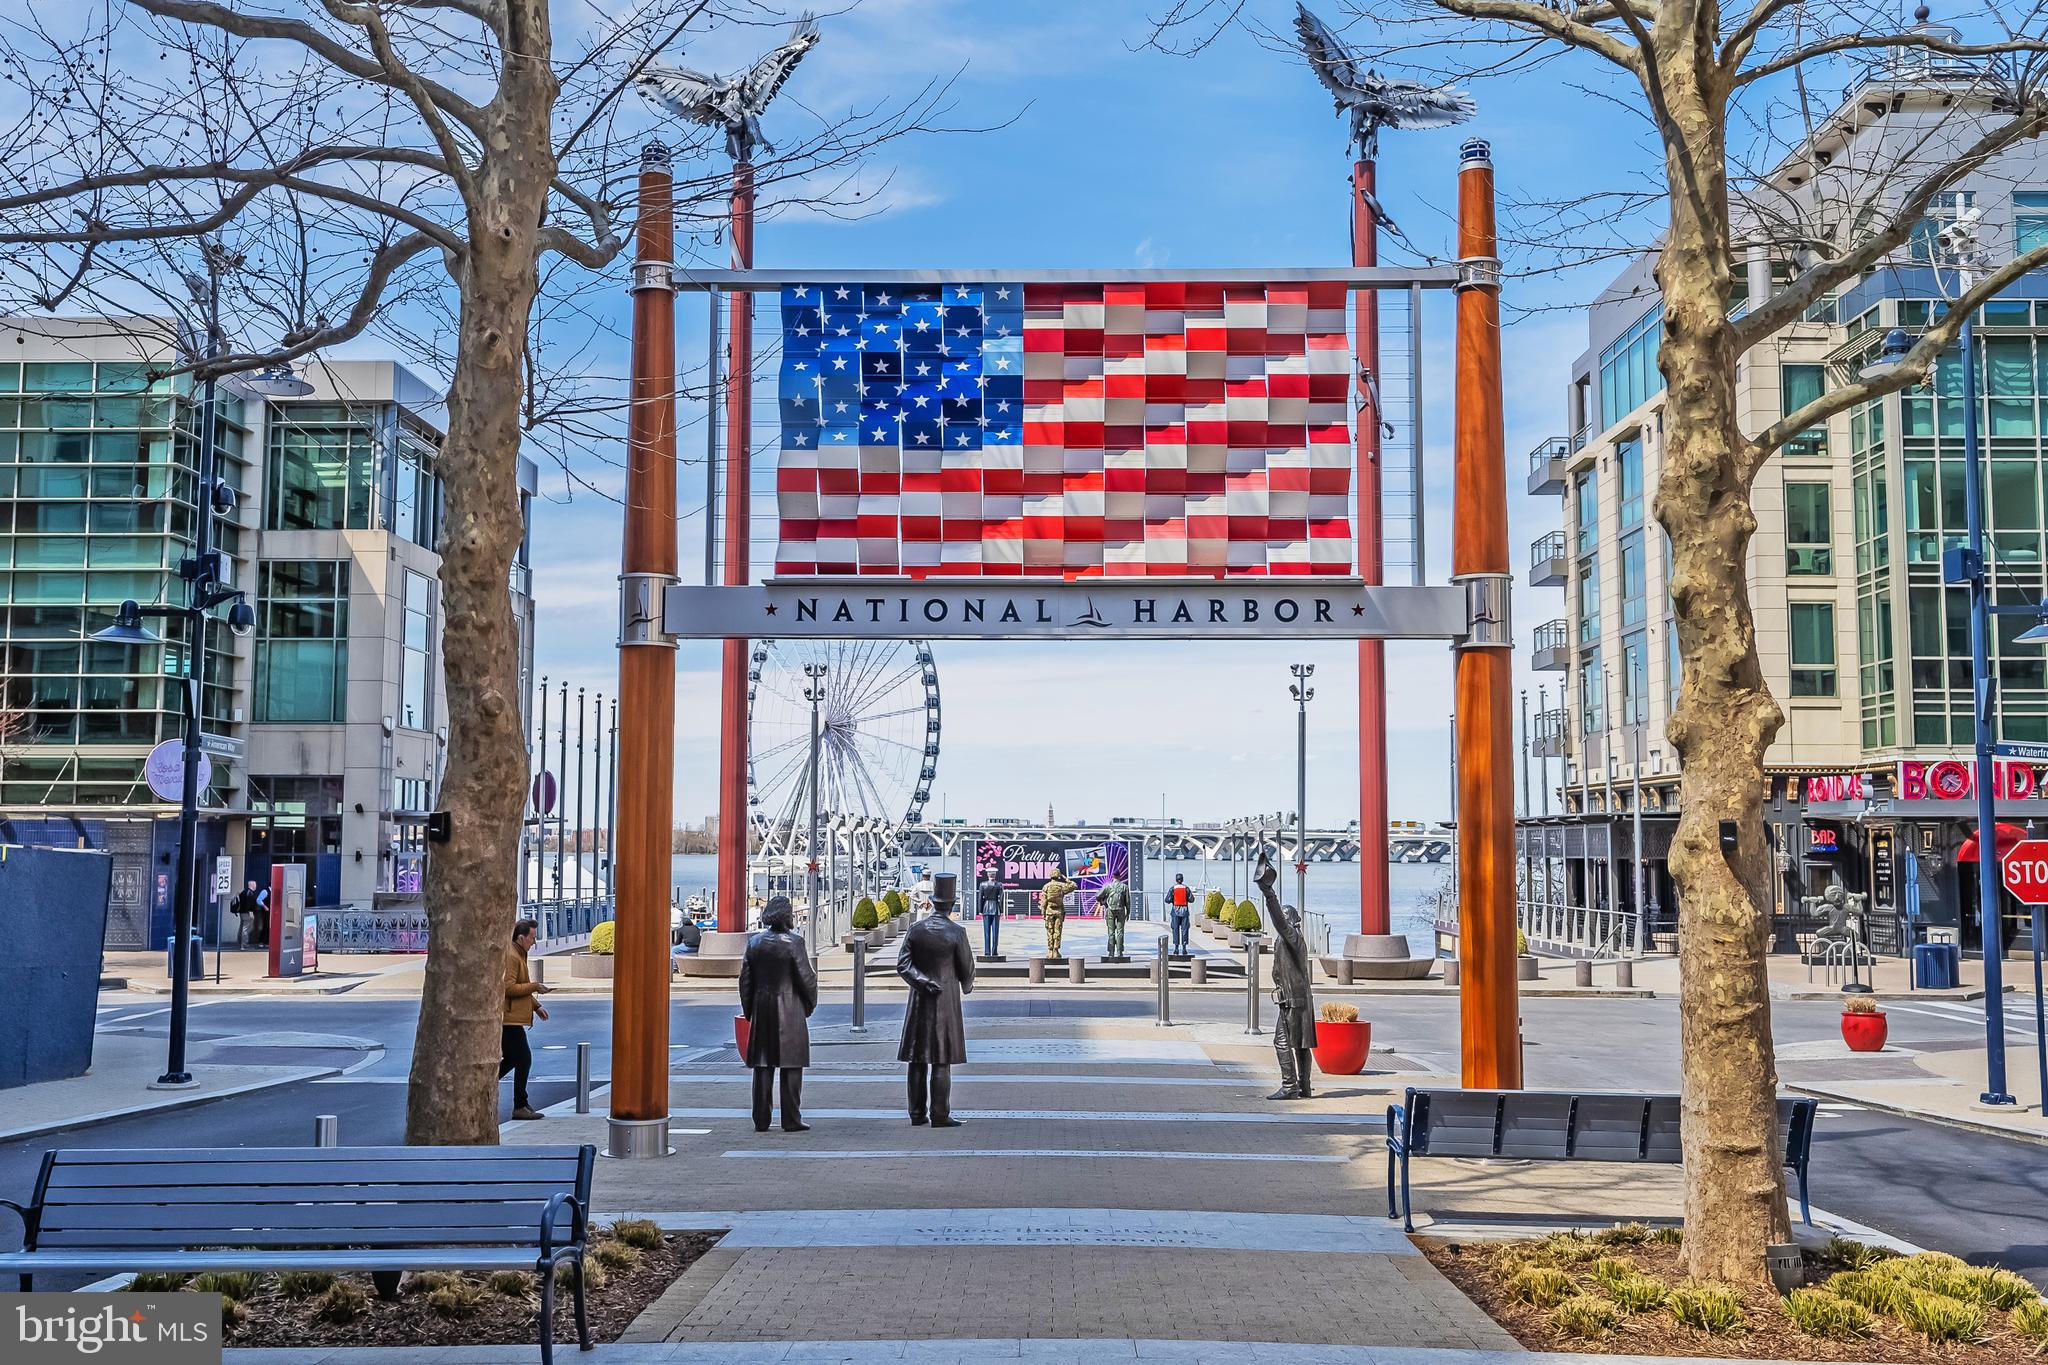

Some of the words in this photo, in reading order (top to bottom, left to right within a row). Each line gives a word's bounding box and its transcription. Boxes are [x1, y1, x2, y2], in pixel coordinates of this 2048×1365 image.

[795, 599, 1052, 622] NATIONAL
[1133, 599, 1335, 623] HARBOR
[1808, 776, 1845, 803] BOND
[1848, 774, 1864, 801] 45
[1811, 829, 1836, 844] BAR
[1002, 844, 1046, 864] Pretty
[1049, 851, 1060, 861] in
[1004, 861, 1061, 880] PINK
[218, 876, 230, 889] 25
